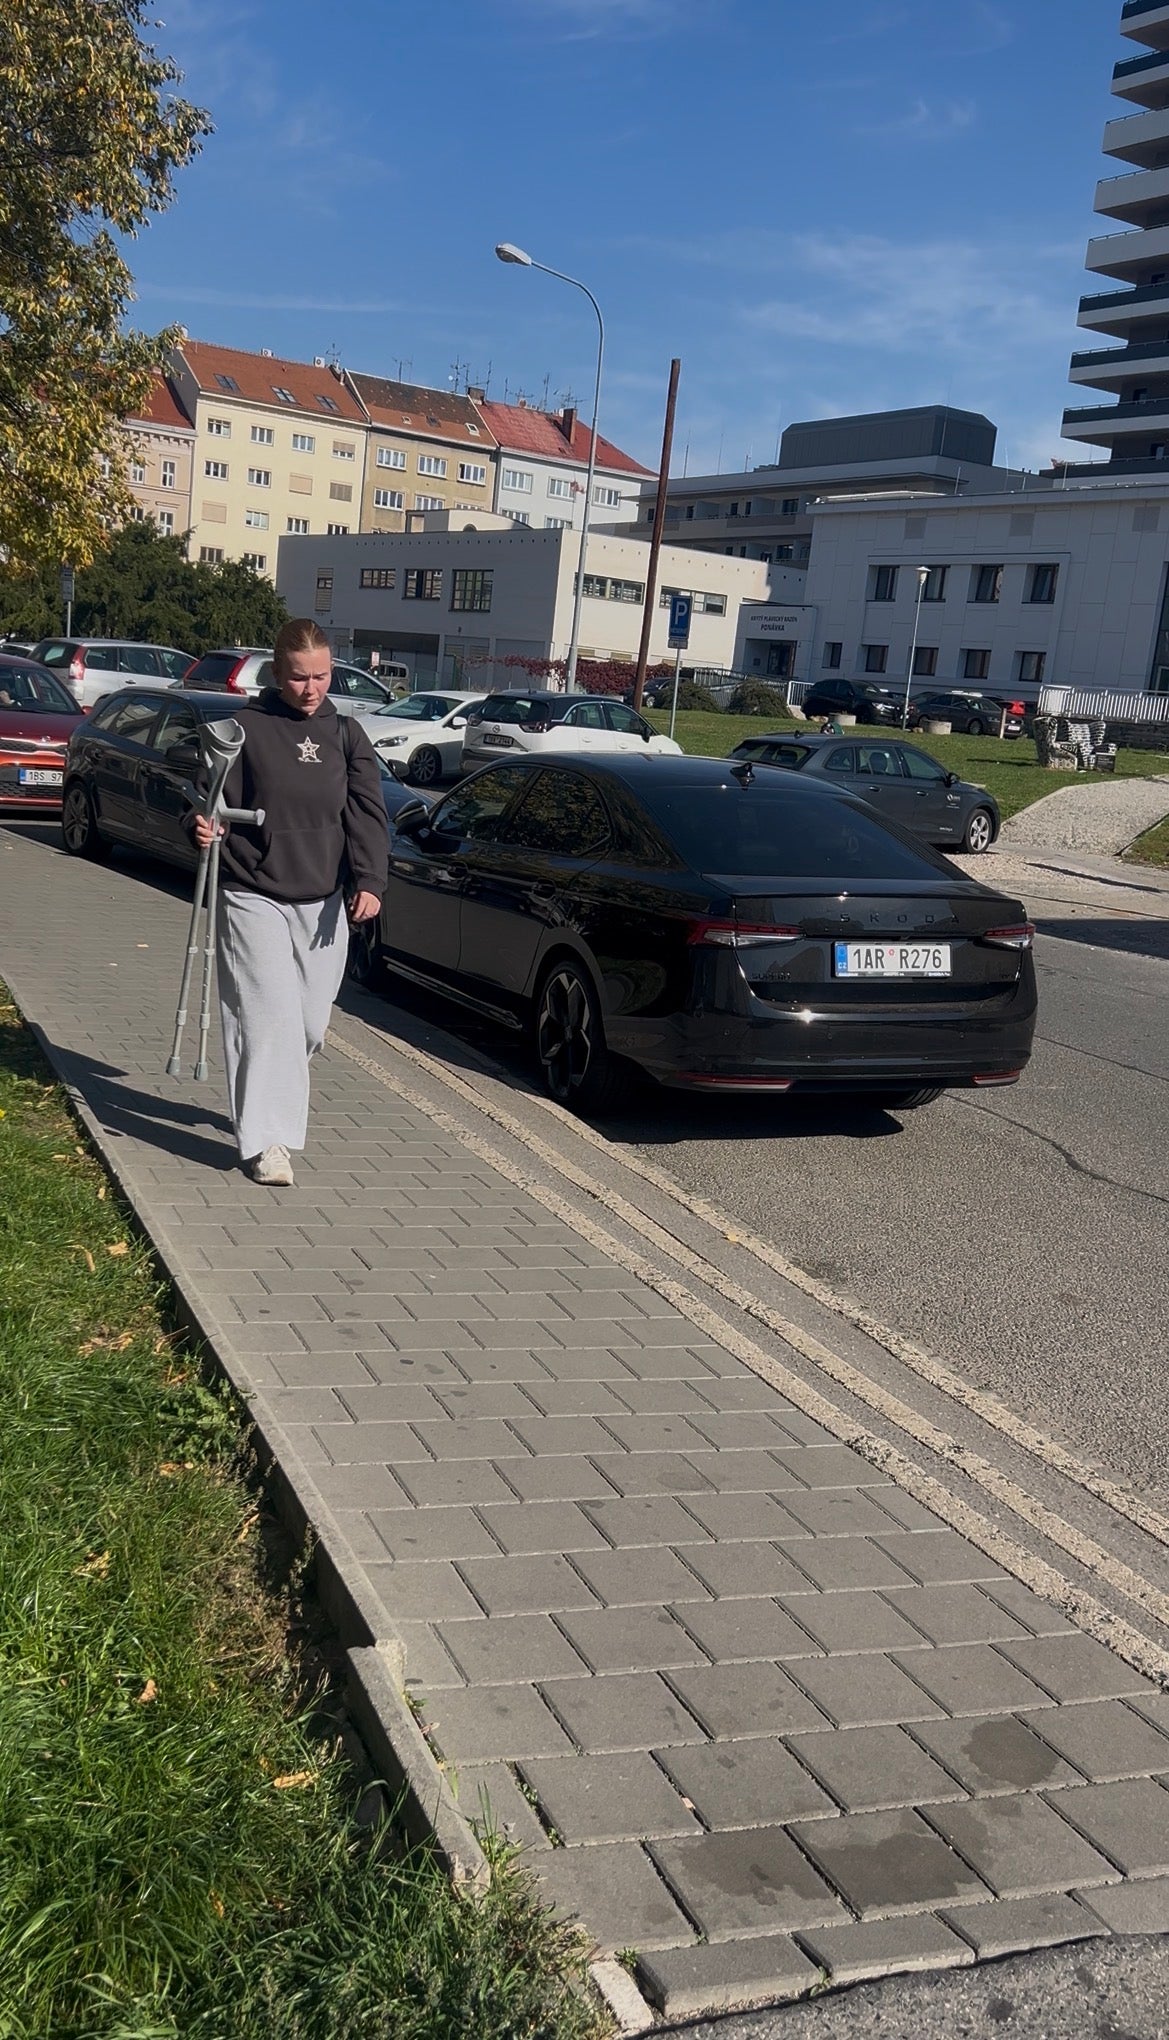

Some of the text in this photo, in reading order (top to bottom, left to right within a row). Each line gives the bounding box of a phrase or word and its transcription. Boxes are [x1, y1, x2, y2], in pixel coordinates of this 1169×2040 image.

[674, 600, 688, 625] P
[853, 948, 942, 969] 1AR R276
